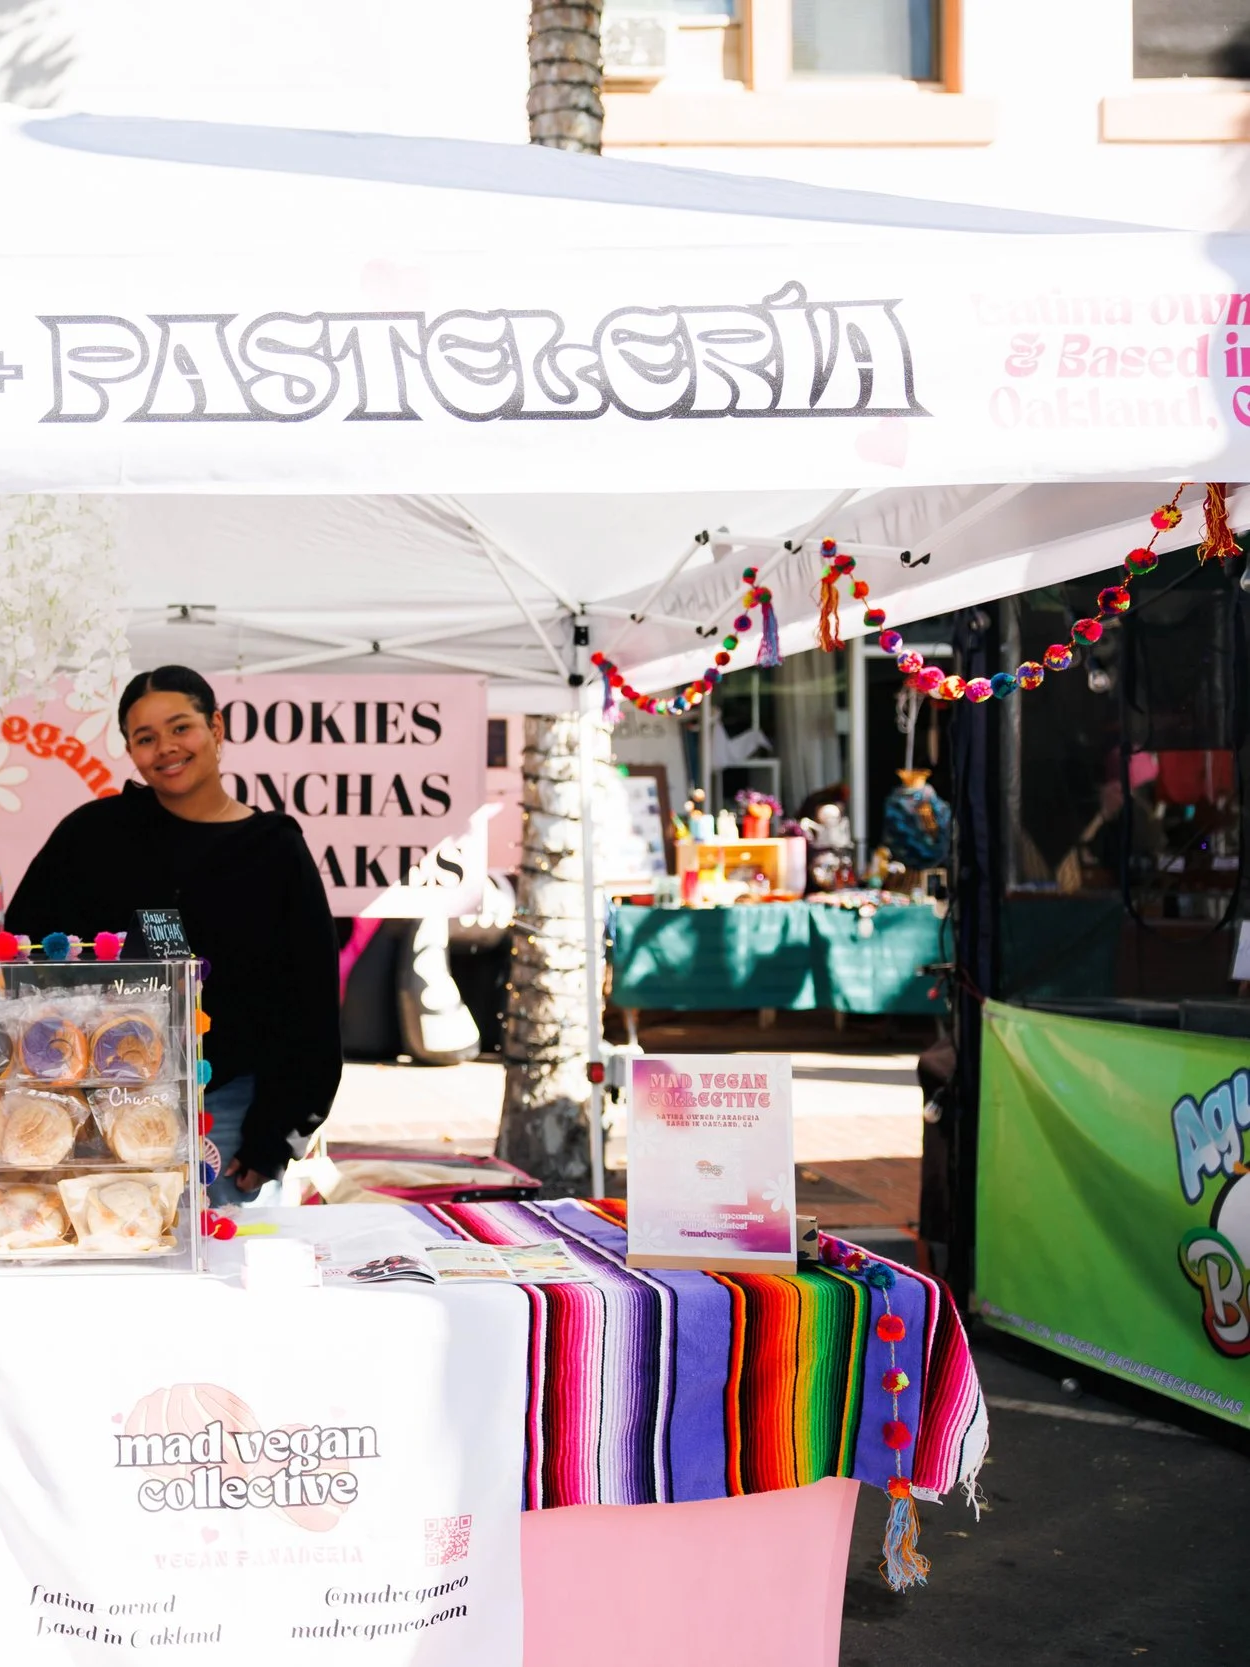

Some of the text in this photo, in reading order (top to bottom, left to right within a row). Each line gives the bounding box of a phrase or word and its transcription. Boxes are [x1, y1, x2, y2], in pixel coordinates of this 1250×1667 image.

[37, 281, 934, 424] PASTELERÍA
[1004, 332, 1047, 378] &
[1057, 333, 1209, 378] Based
[988, 386, 1218, 431] Oakland,
[223, 700, 442, 745] OOKIES
[218, 773, 452, 818] ONCHAS
[319, 845, 464, 888] AKES
[114, 977, 171, 996] Vanilla
[109, 1087, 168, 1107] Churro
[648, 1091, 770, 1108] COLLECTIVE
[650, 1073, 768, 1089] MAD VEGAN
[719, 1212, 764, 1223] upcoming
[115, 1420, 381, 1476] mad vegan
[138, 1465, 358, 1512] collective
[154, 1549, 228, 1569] VEGAN
[325, 1573, 469, 1607] @madveganco
[104, 1628, 123, 1646] in
[291, 1604, 468, 1641] madveganco.com
